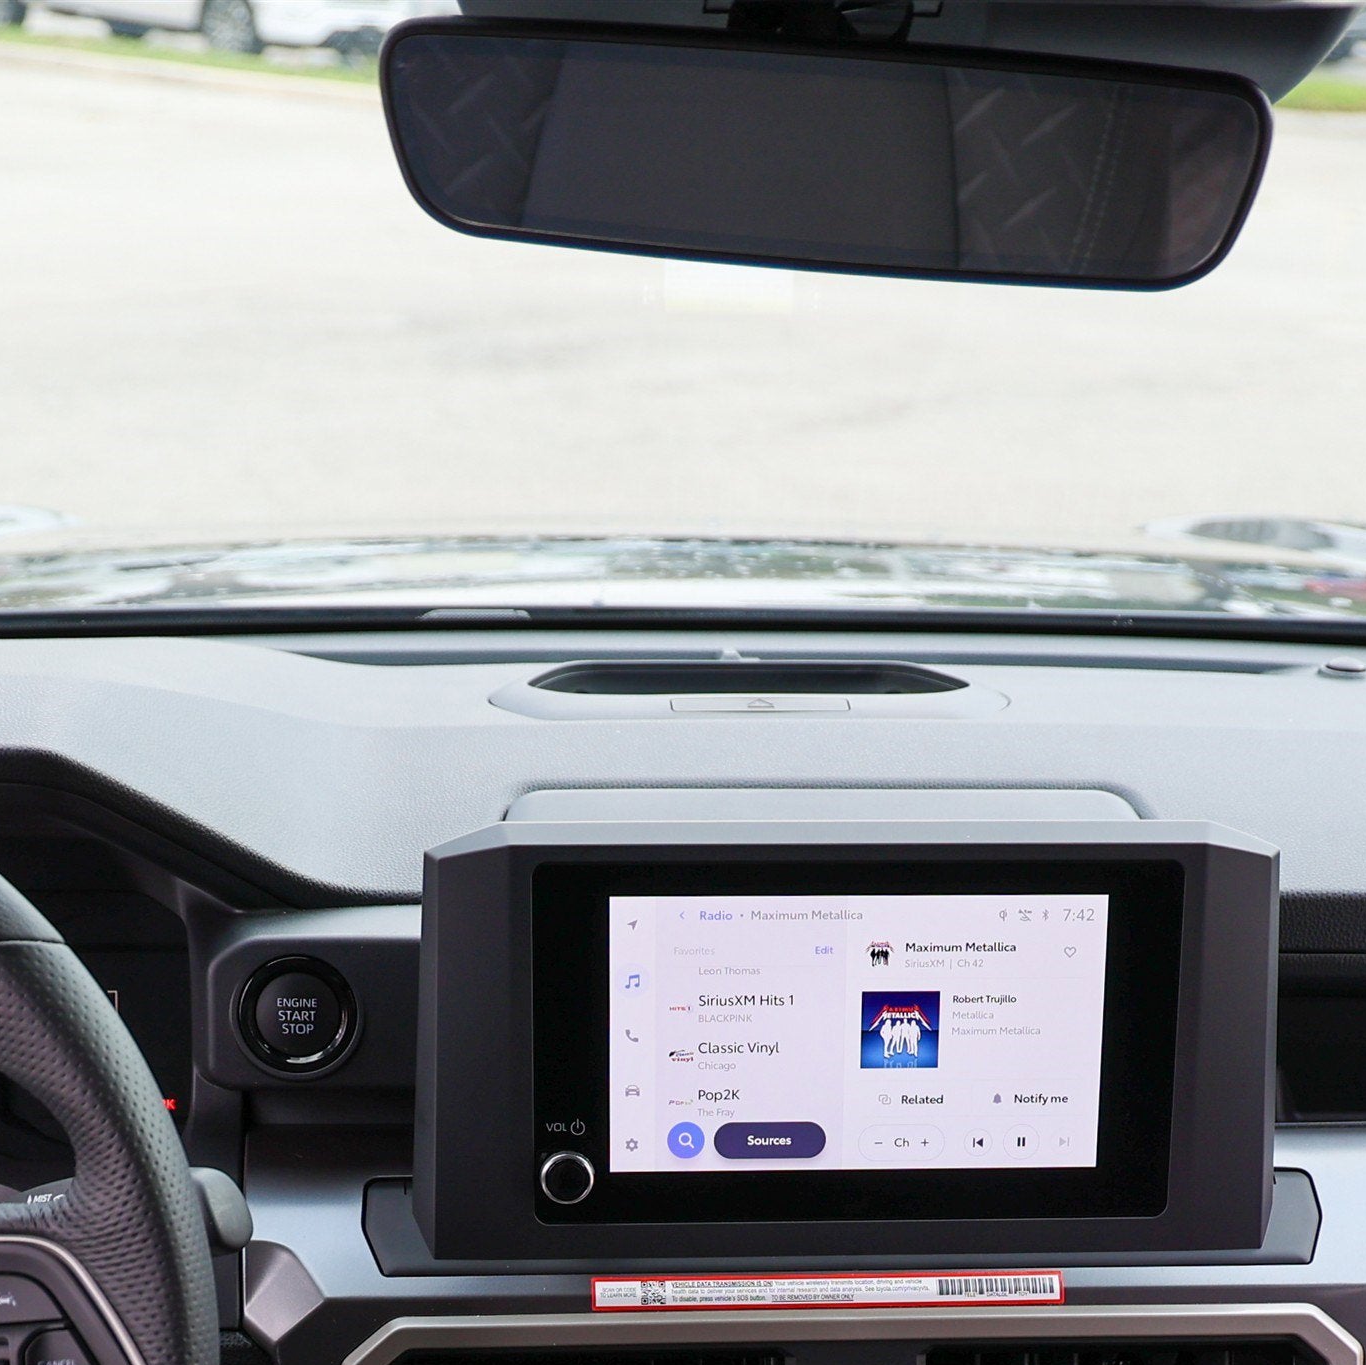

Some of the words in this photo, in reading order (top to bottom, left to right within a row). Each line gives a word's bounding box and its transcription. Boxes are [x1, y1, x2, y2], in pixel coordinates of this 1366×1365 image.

[700, 911, 733, 920] Radio
[751, 910, 808, 920] Maximum
[811, 910, 863, 920] Metallica
[1063, 909, 1095, 921] 7:42
[673, 947, 715, 955] Favorites
[815, 946, 834, 954] Edit
[905, 942, 962, 952] Maximum
[966, 942, 1017, 952] Metallica
[905, 959, 945, 967] SiriusXM
[957, 959, 971, 967] Ch
[972, 959, 984, 967] 42
[698, 967, 722, 975] Leon
[725, 967, 761, 975] Thomas
[276, 998, 317, 1007] ENGINE
[698, 995, 756, 1006] SiriusXM
[760, 995, 785, 1005] Hits
[789, 995, 794, 1005] 1
[952, 995, 984, 1003] Robert
[986, 995, 1017, 1005] Trujillo
[278, 1010, 316, 1021] START
[698, 1014, 752, 1022] BLACKPINK
[952, 1011, 994, 1019] Metallica
[282, 1023, 314, 1034] STOP
[952, 1027, 997, 1035] Maximum
[999, 1027, 1041, 1035] Metallica
[698, 1042, 744, 1053] Classic
[747, 1042, 779, 1056] Vinyl
[698, 1062, 736, 1071] Chicago
[698, 1089, 740, 1102] Pop2K
[901, 1094, 944, 1104] Related
[1014, 1094, 1048, 1106] Notify
[698, 1108, 714, 1116] The
[717, 1108, 735, 1118] Fray
[546, 1123, 567, 1132] VOL
[747, 1135, 791, 1146] Sources
[894, 1138, 909, 1147] Ch
[33, 1194, 52, 1202] MIST
